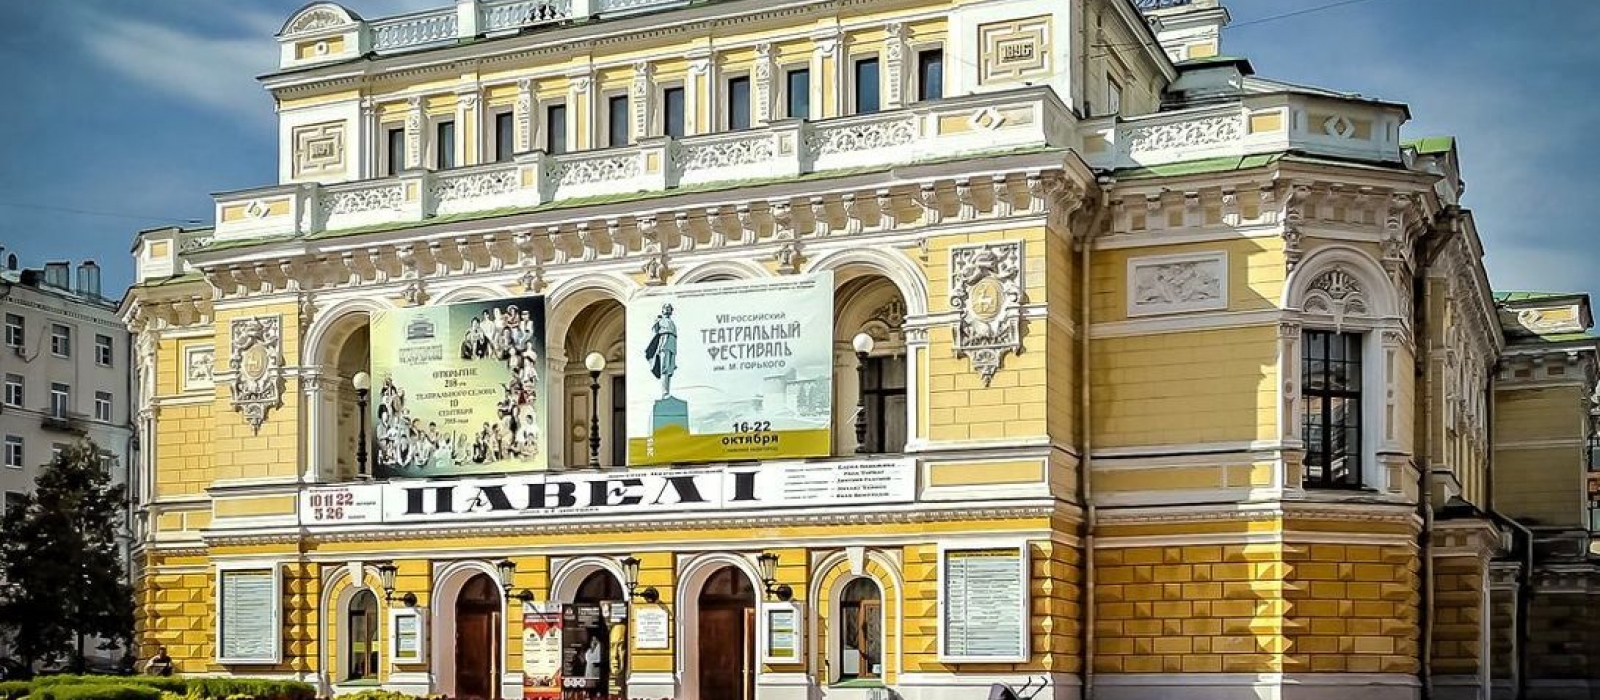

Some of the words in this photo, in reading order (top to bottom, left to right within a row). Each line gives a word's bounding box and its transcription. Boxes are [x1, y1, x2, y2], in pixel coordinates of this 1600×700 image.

[700, 321, 801, 344] ТЕАТРАЛЬНЫЙ
[707, 342, 793, 361] ФЕСТИВАЛЬ
[740, 360, 786, 370] ГОРЬКОГО
[732, 421, 772, 434] 16-22
[721, 433, 779, 446] октября
[310, 494, 323, 508] 10
[336, 493, 353, 506] 22
[326, 507, 344, 520] 26
